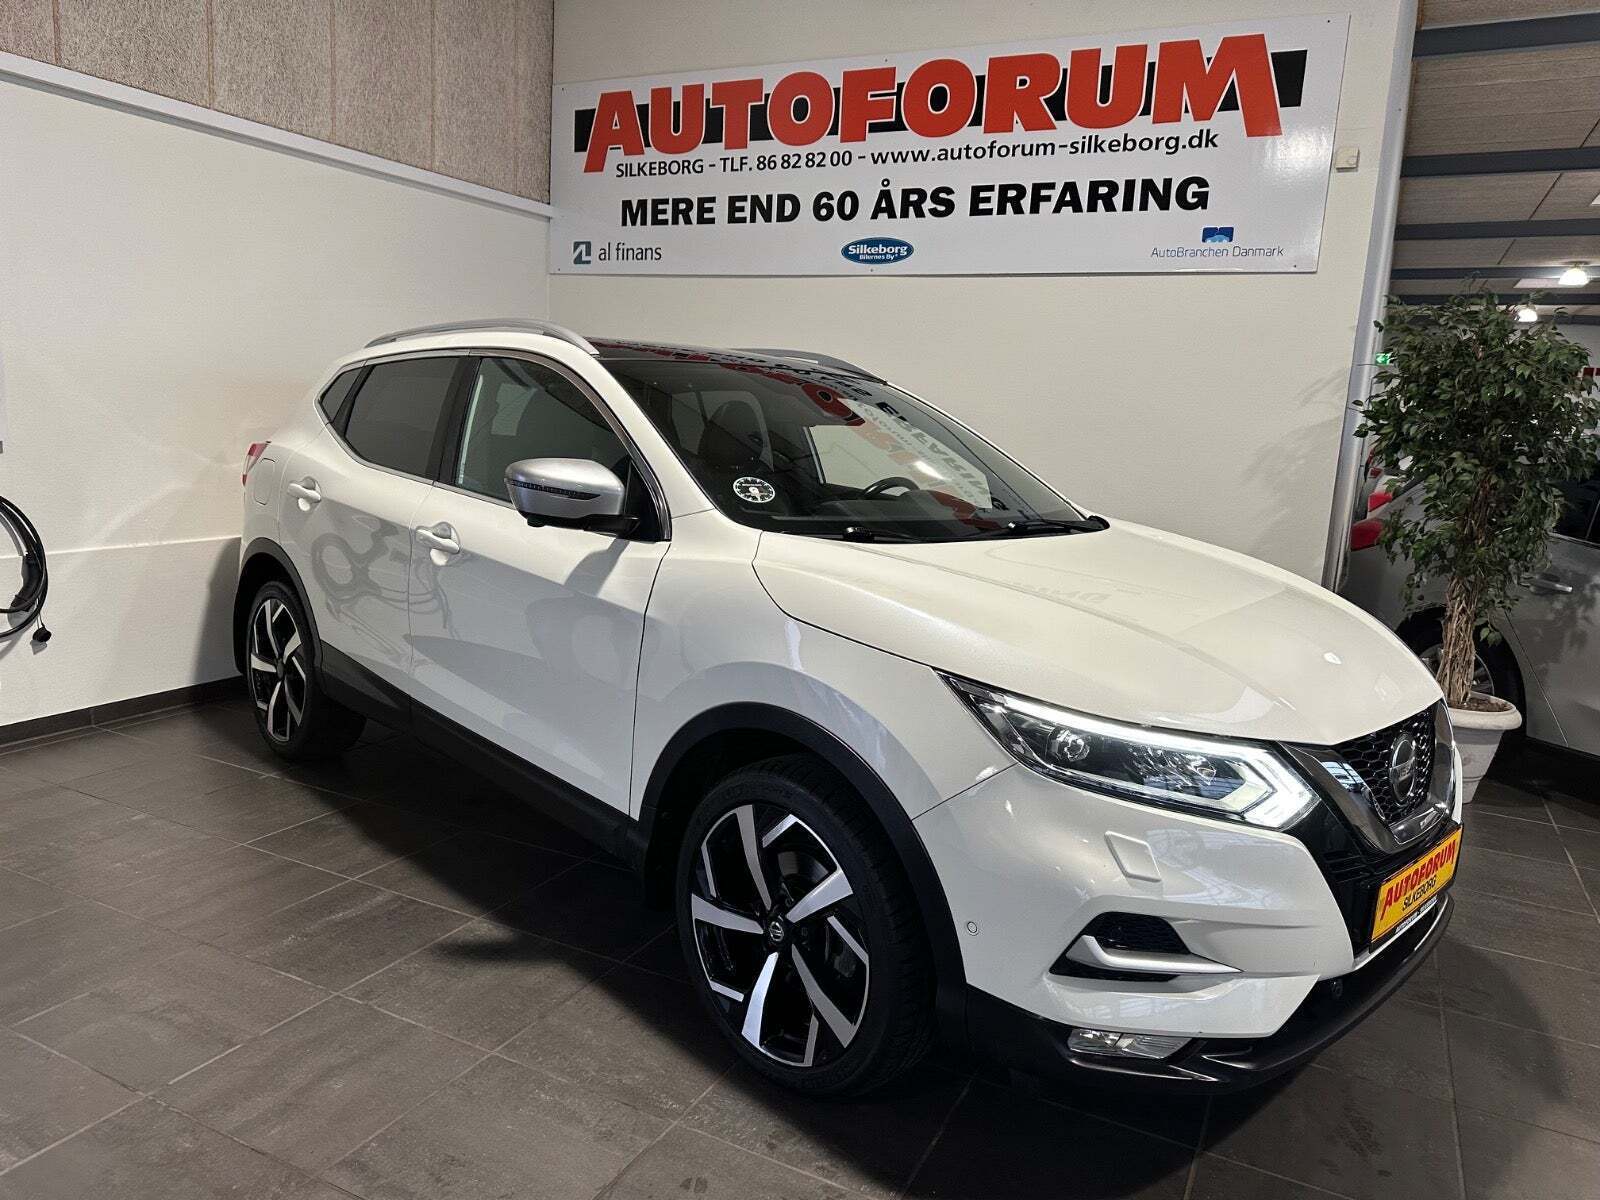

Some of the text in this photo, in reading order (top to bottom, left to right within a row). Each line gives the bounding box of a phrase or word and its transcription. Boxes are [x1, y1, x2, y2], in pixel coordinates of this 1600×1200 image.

[584, 33, 1283, 173] AUTOFORUM
[615, 158, 704, 178] SILKEBORG
[720, 156, 752, 172] TLF.
[870, 129, 1219, 165] www.autoforum-silkeborg.dk
[621, 176, 1210, 227] MERE END 60 ÅRS ERFARING
[598, 242, 662, 261] al finans
[848, 244, 908, 256] Silkeborg
[1151, 245, 1284, 258] AutoBranchen Danmark
[1380, 839, 1456, 921] AUTOFORUM
[1402, 875, 1437, 911] SILKEBORG
